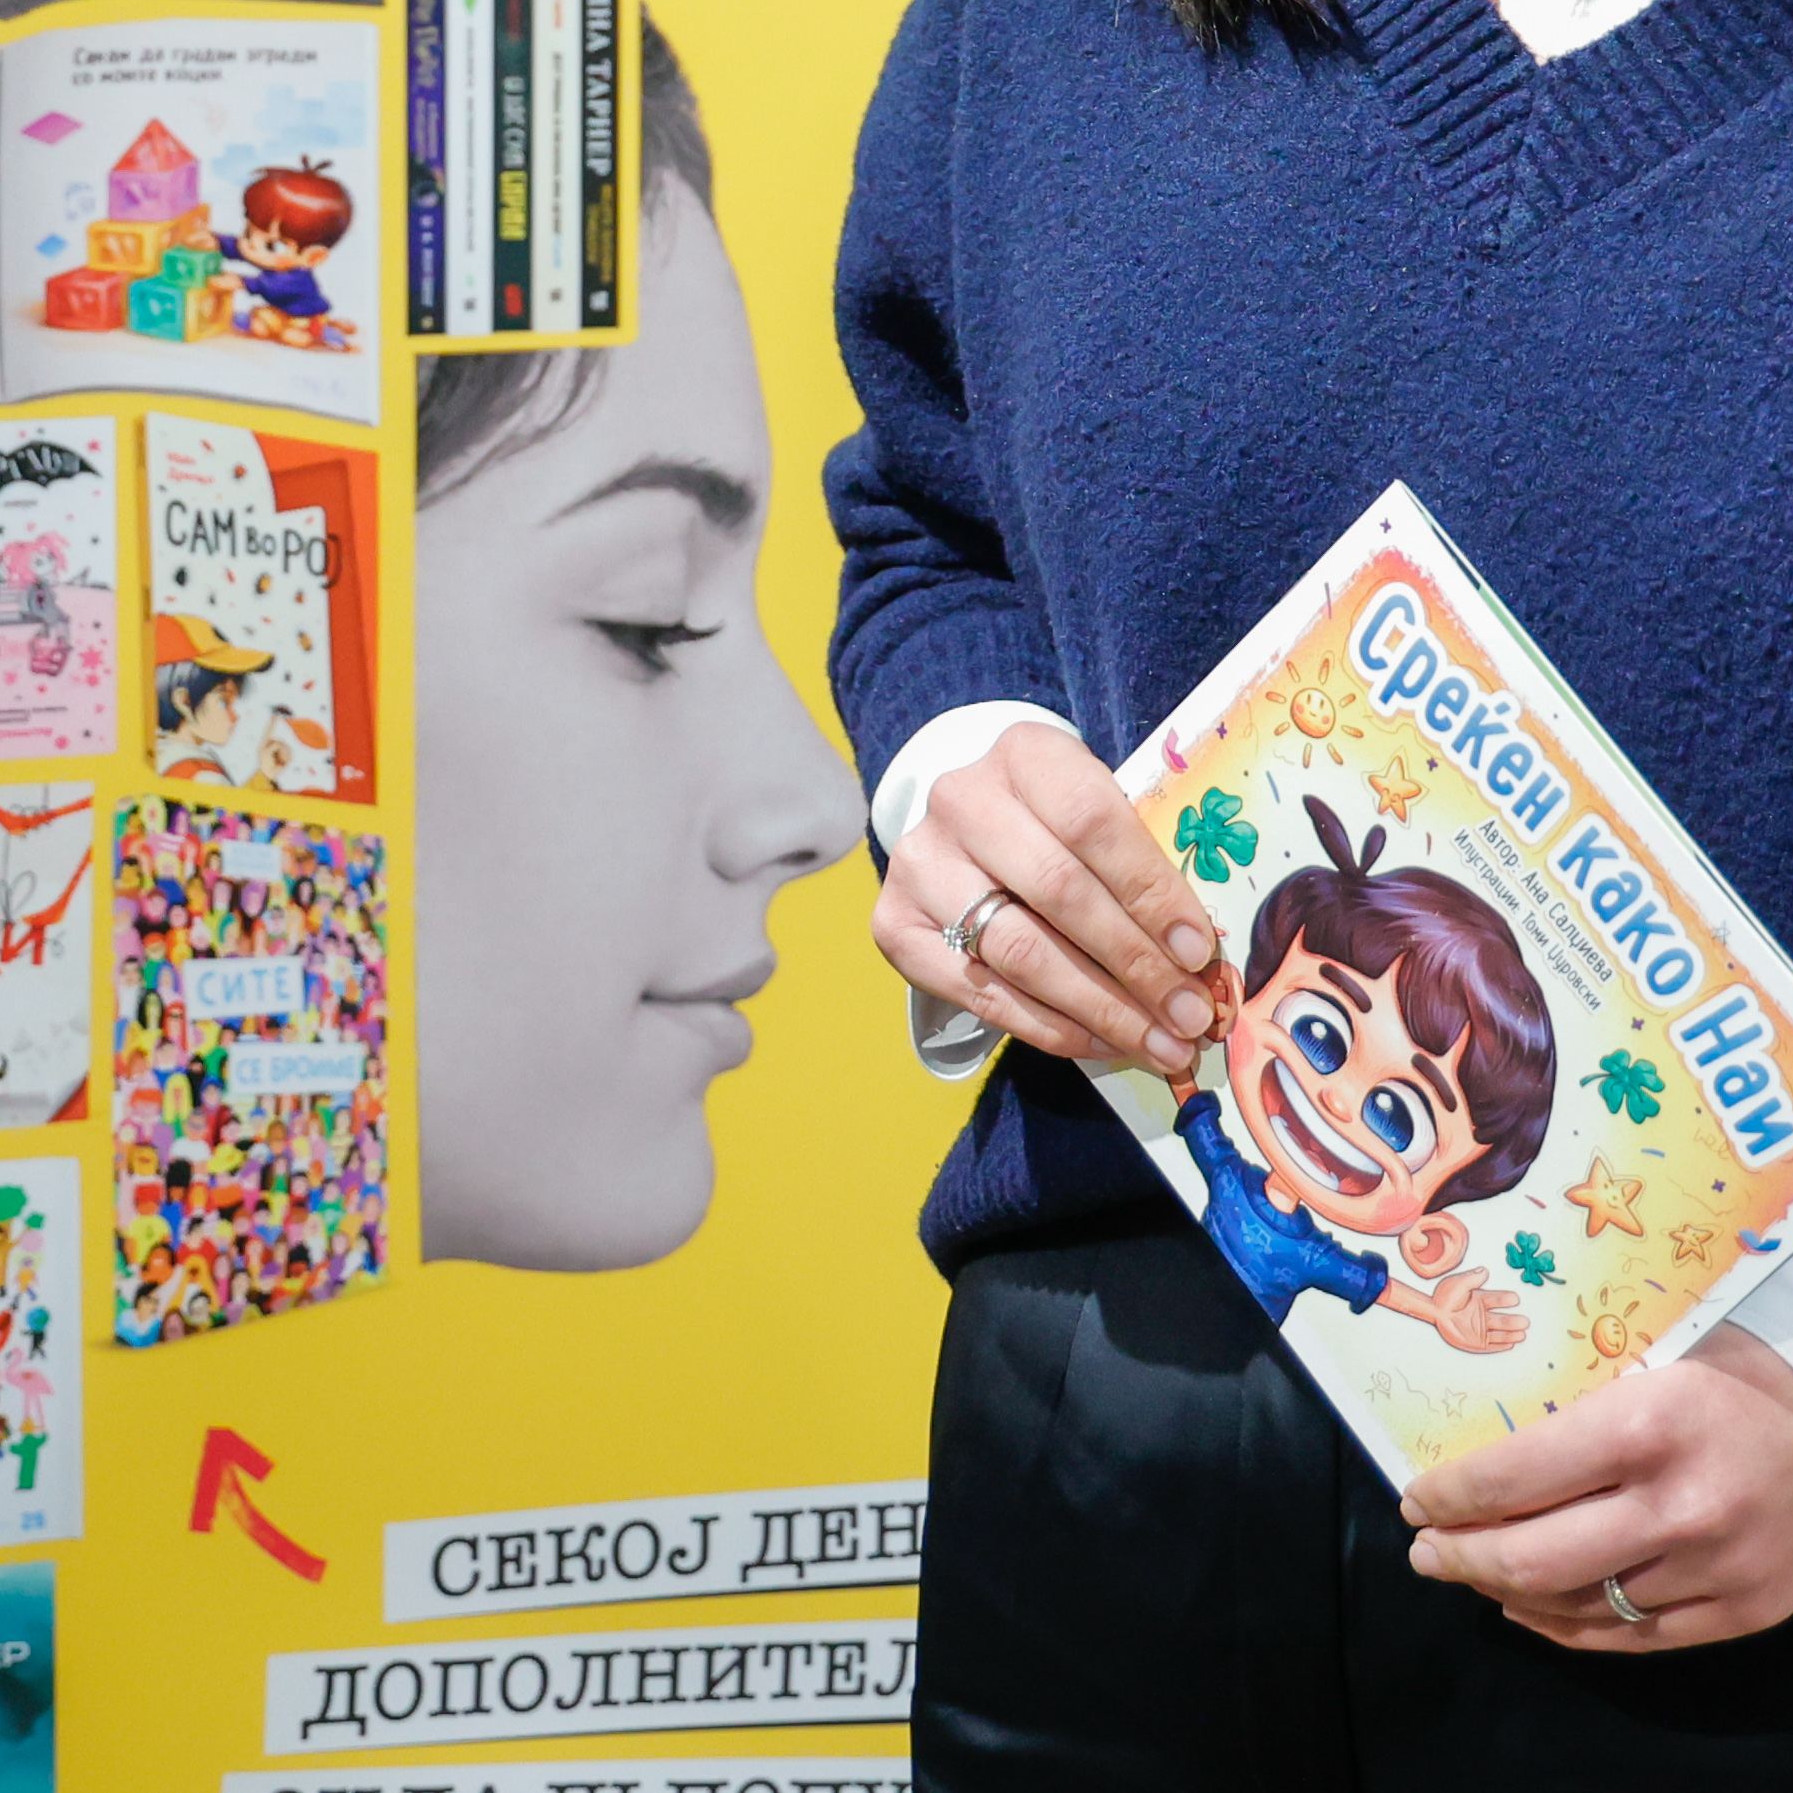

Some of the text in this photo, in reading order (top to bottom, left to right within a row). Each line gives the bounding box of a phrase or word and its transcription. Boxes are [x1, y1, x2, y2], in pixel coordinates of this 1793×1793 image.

[165, 499, 237, 558] САМ
[1358, 592, 1567, 834] Среќен
[1557, 824, 1698, 998] како
[1454, 828, 1602, 1012] Илустрации: Томи Џуровски
[1478, 820, 1613, 983] Автор: Ана Салџиева
[195, 966, 293, 1006] СИТЕ
[431, 1501, 925, 1598] СЕКОЈ ДЕН
